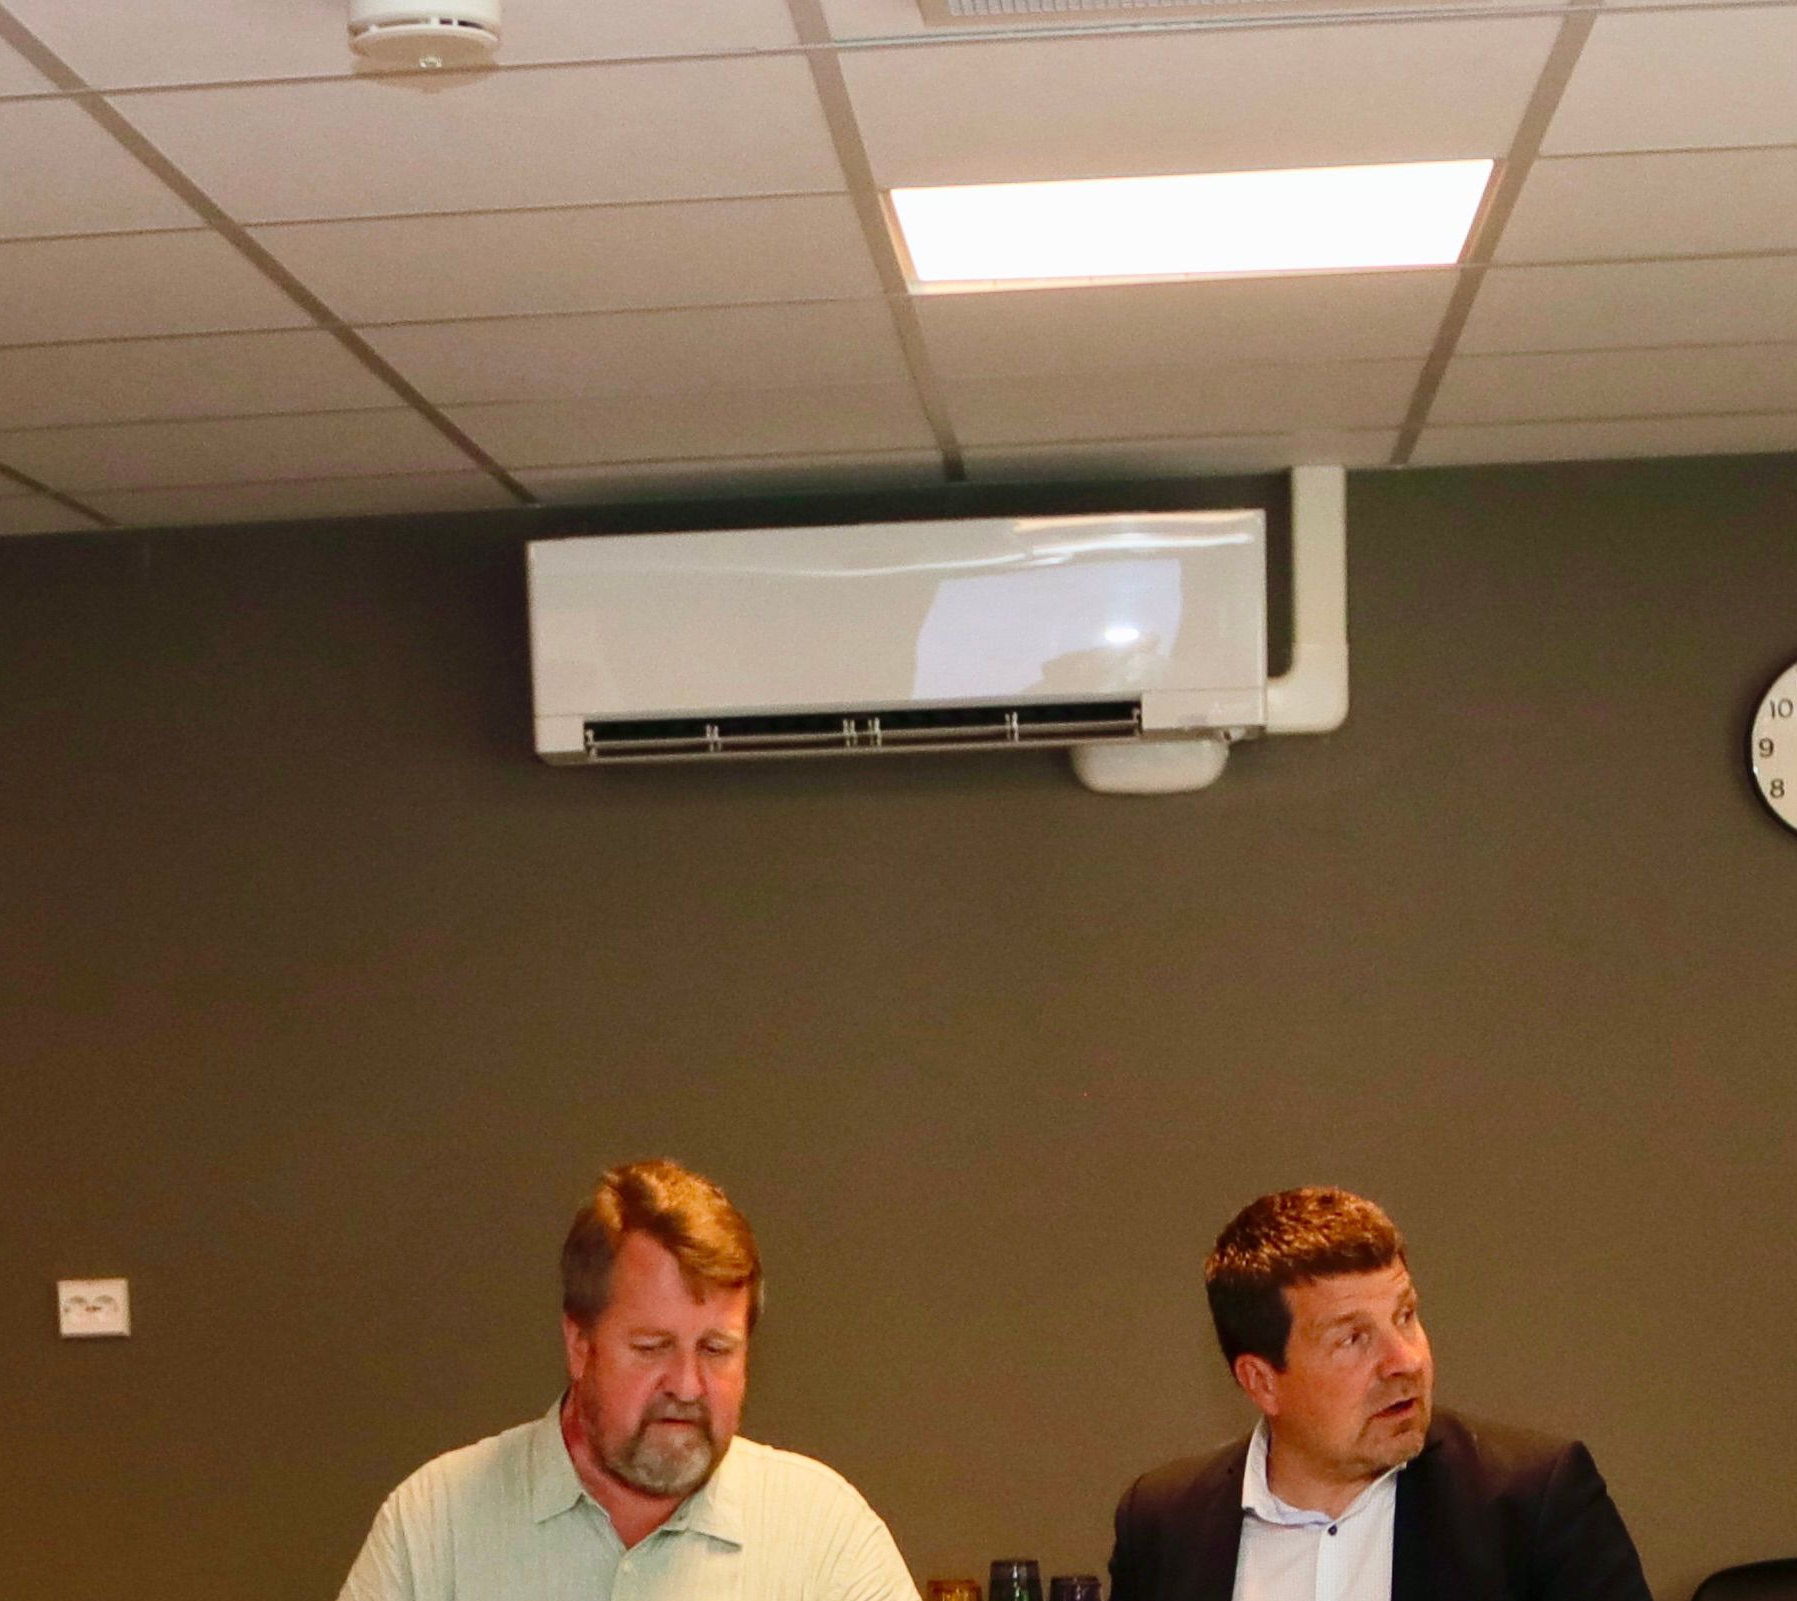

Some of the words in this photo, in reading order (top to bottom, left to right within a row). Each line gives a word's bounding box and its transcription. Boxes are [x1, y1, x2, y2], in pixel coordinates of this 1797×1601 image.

[1770, 699, 1794, 719] 10
[1759, 738, 1774, 757] 9
[1770, 779, 1785, 798] 8
